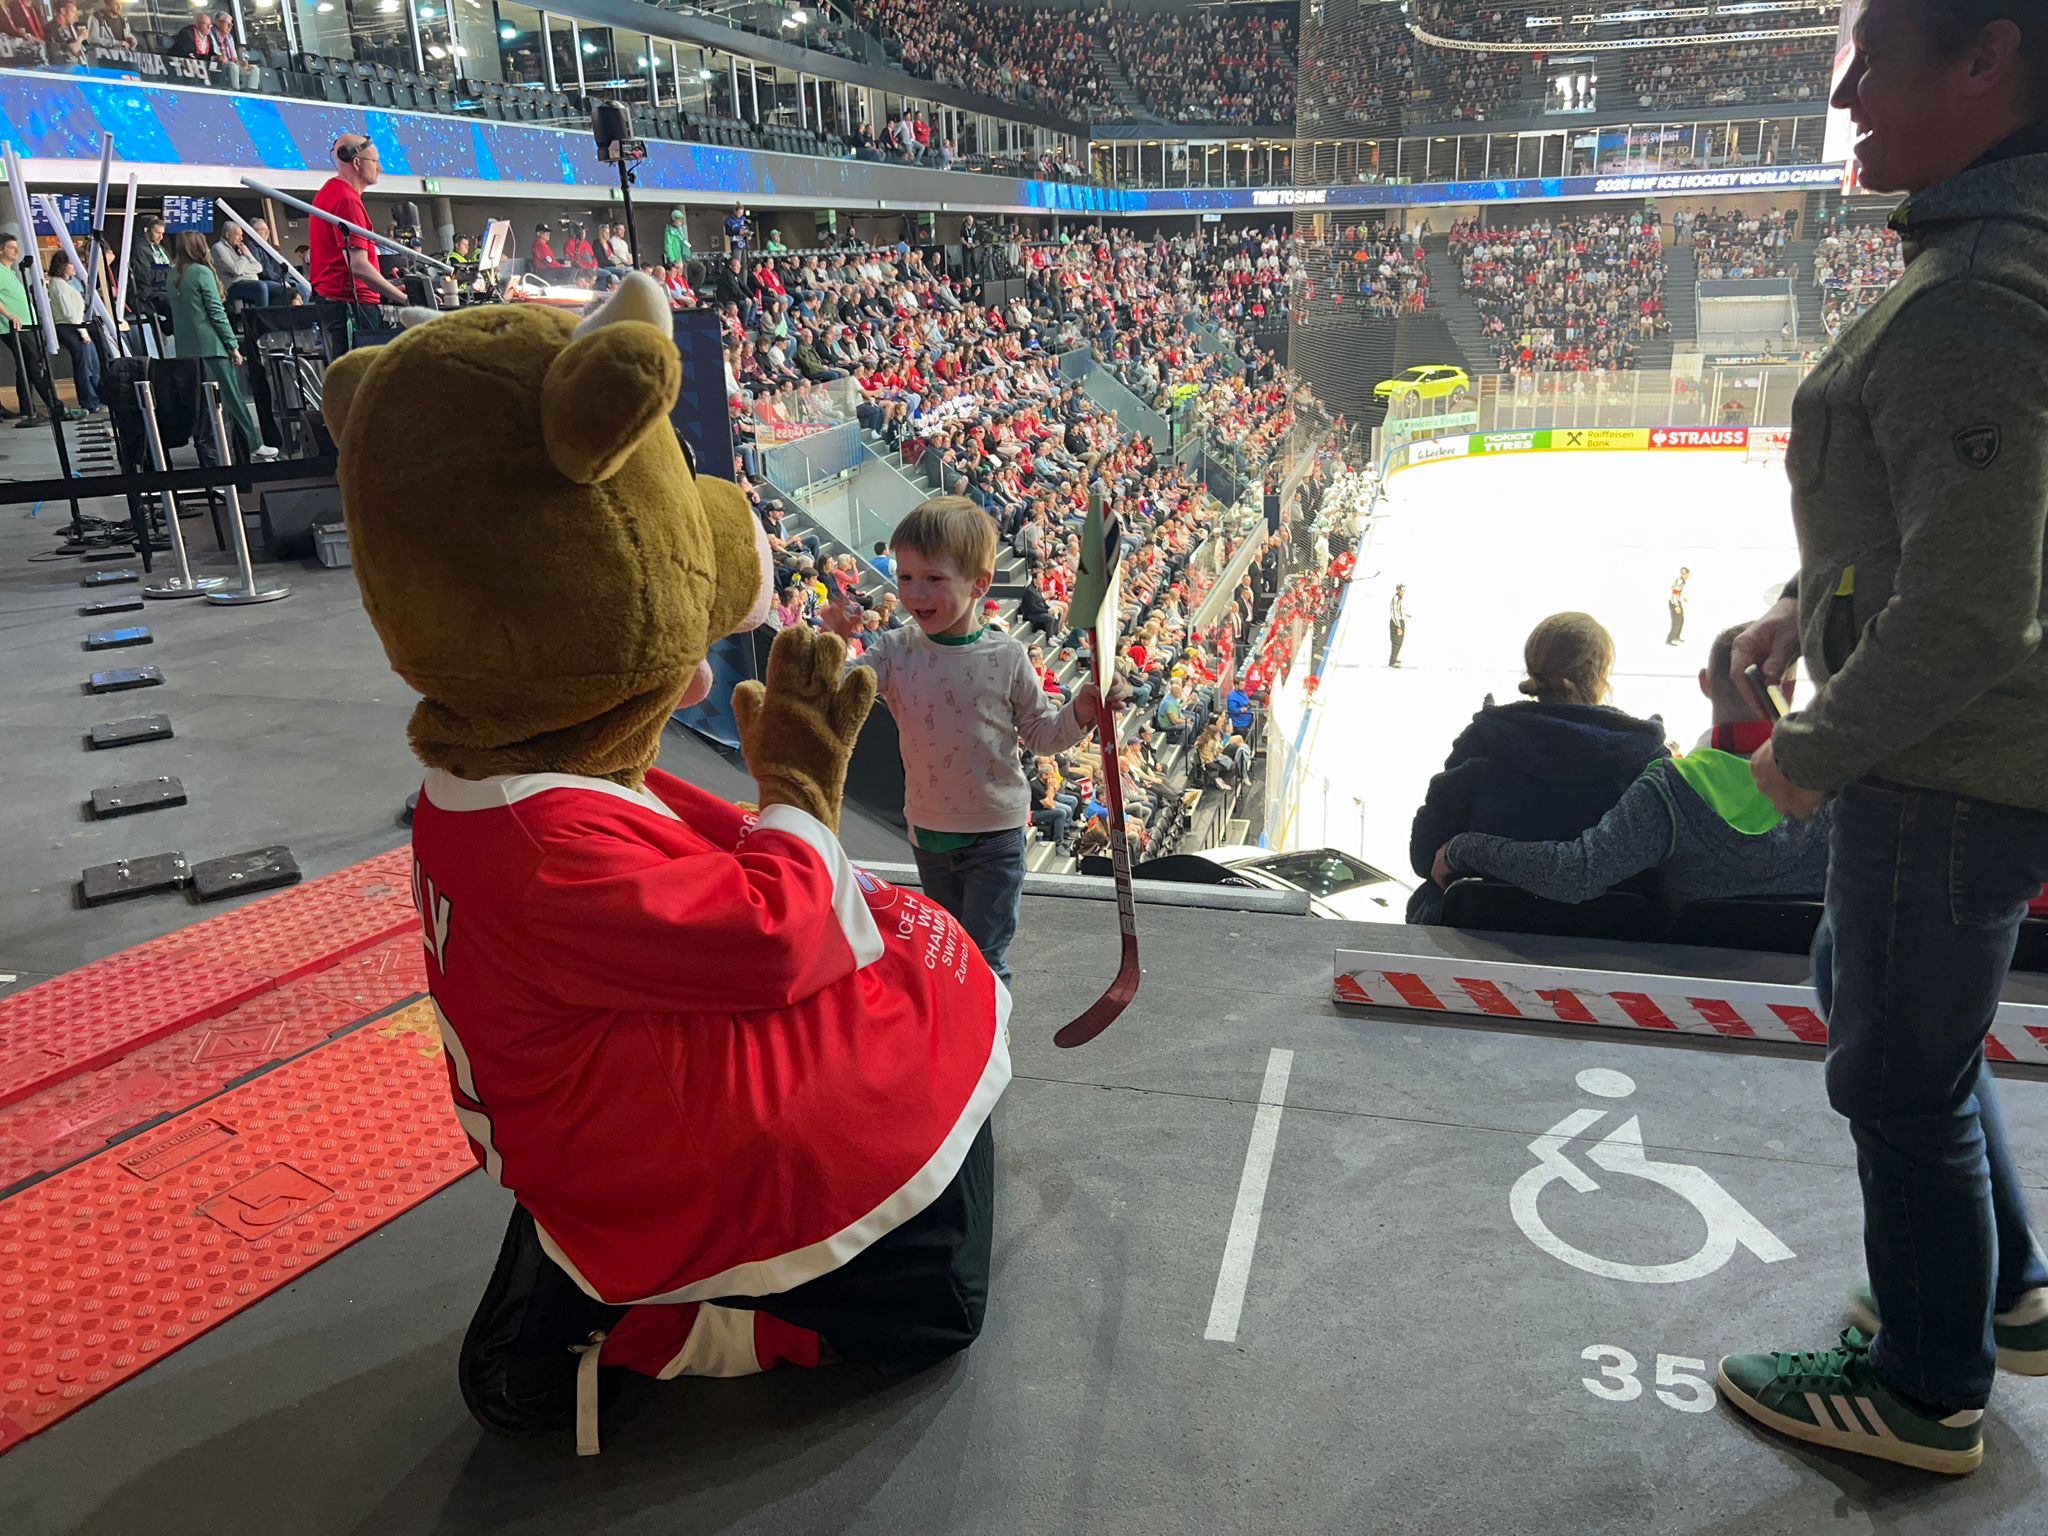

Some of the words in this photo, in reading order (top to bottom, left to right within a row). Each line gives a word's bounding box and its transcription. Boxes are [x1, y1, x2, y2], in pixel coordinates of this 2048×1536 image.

[1657, 176, 1680, 189] ICE
[1681, 172, 1738, 188] HOCKEY
[1739, 171, 1790, 186] WORLD
[1252, 190, 1279, 205] TIME
[1278, 190, 1295, 204] TO
[1294, 189, 1327, 204] SHINE
[1588, 430, 1634, 439] Raiffeisen
[1668, 430, 1744, 445] STRAUSS
[1484, 440, 1533, 451] TYRES
[895, 911, 916, 940] ICE
[955, 942, 969, 984] Zurich
[1581, 1344, 1717, 1413] 35
